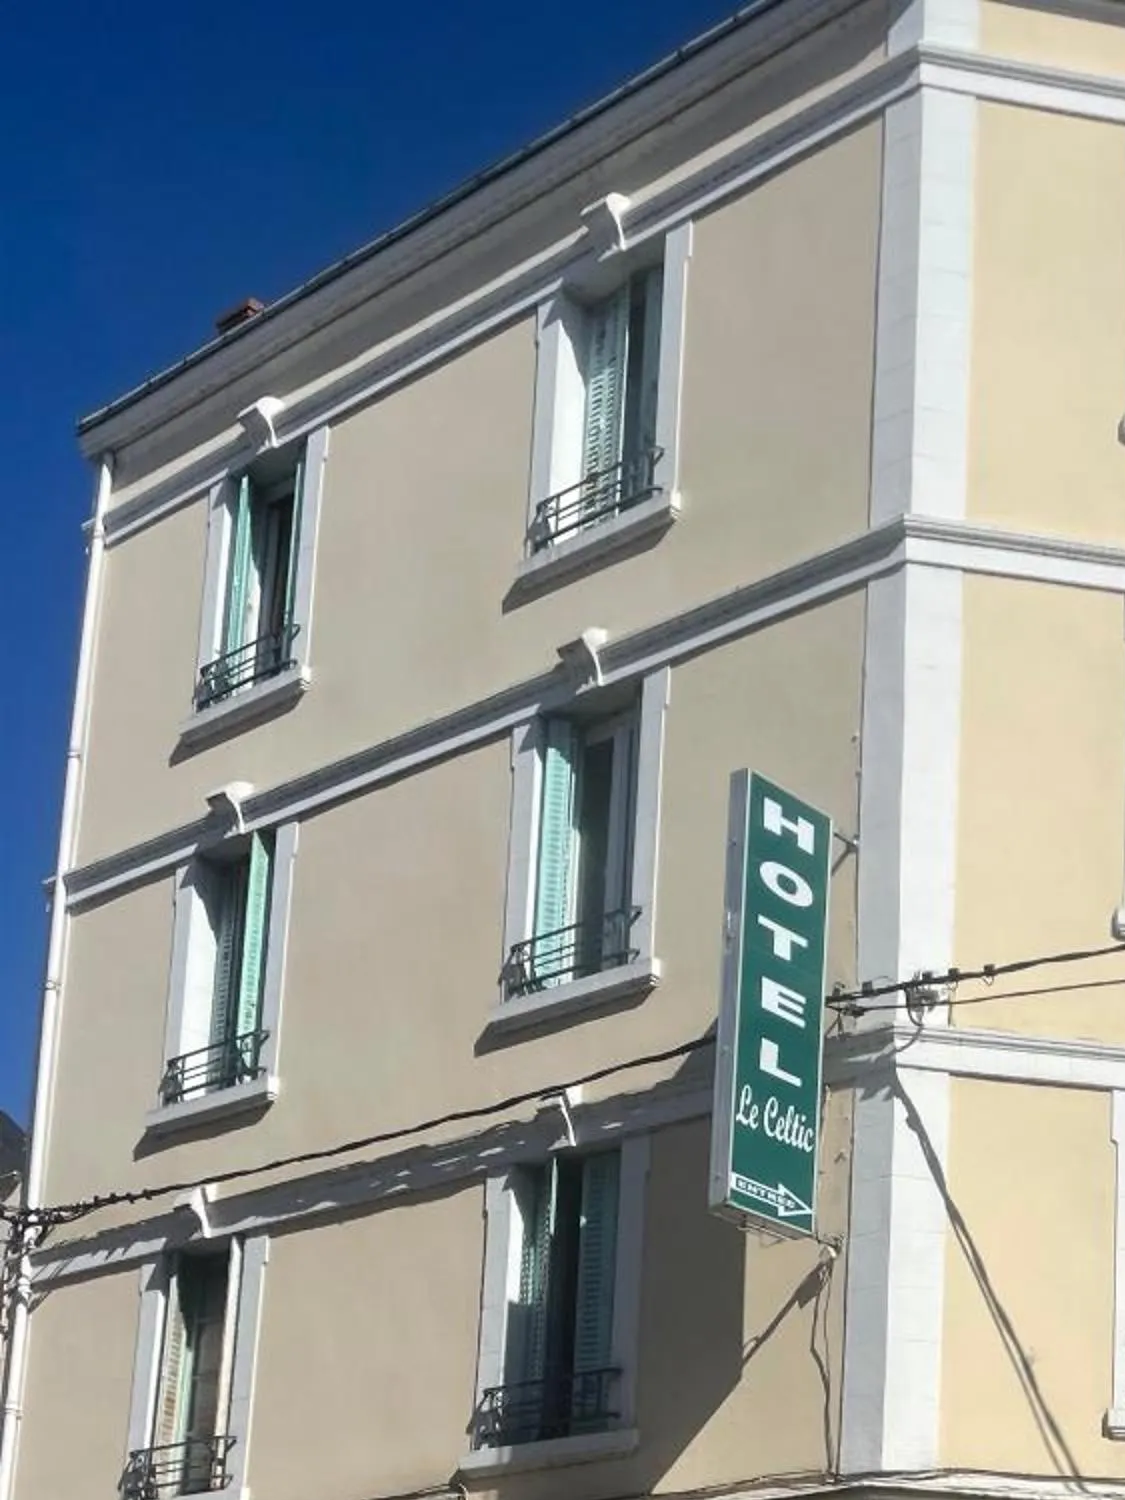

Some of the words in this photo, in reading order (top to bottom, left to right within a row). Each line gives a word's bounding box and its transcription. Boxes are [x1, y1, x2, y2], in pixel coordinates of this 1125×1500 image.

[757, 797, 815, 1087] HOTEL
[736, 1084, 759, 1130] Le
[763, 1096, 815, 1152] Celtic
